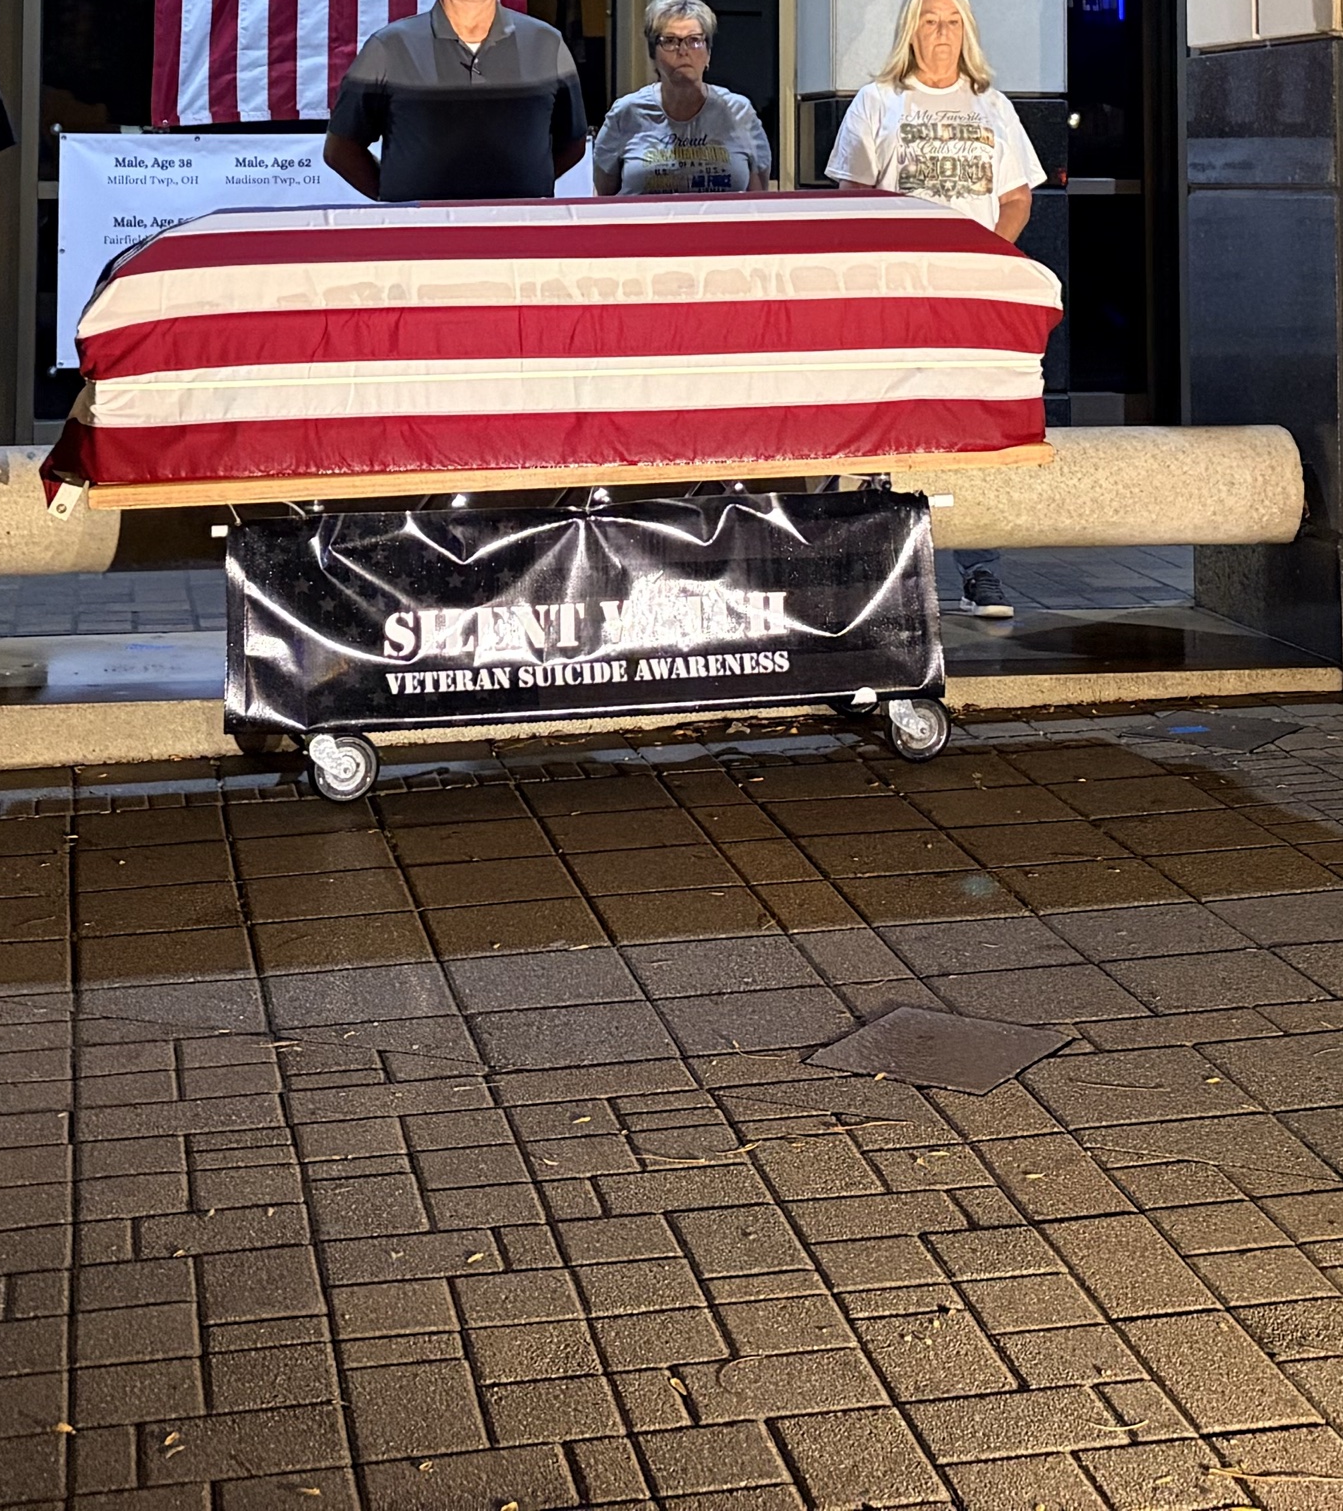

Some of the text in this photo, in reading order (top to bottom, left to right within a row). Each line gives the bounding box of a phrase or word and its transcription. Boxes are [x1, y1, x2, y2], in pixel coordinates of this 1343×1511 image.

[905, 109, 982, 123] My Favorite
[659, 133, 708, 148] Proud
[916, 140, 978, 155] Calls Me
[114, 156, 193, 171] Male, Age 38
[234, 156, 312, 171] Male, Age 62
[916, 154, 983, 184] MOM
[107, 175, 199, 187] Milford Twp., OH
[225, 175, 321, 187] Madison Twp., OH
[113, 216, 147, 229] Male,
[150, 216, 175, 230] Age
[383, 600, 585, 657] SILENT
[386, 650, 790, 695] VETERAN SUICIDE AWARENESS
